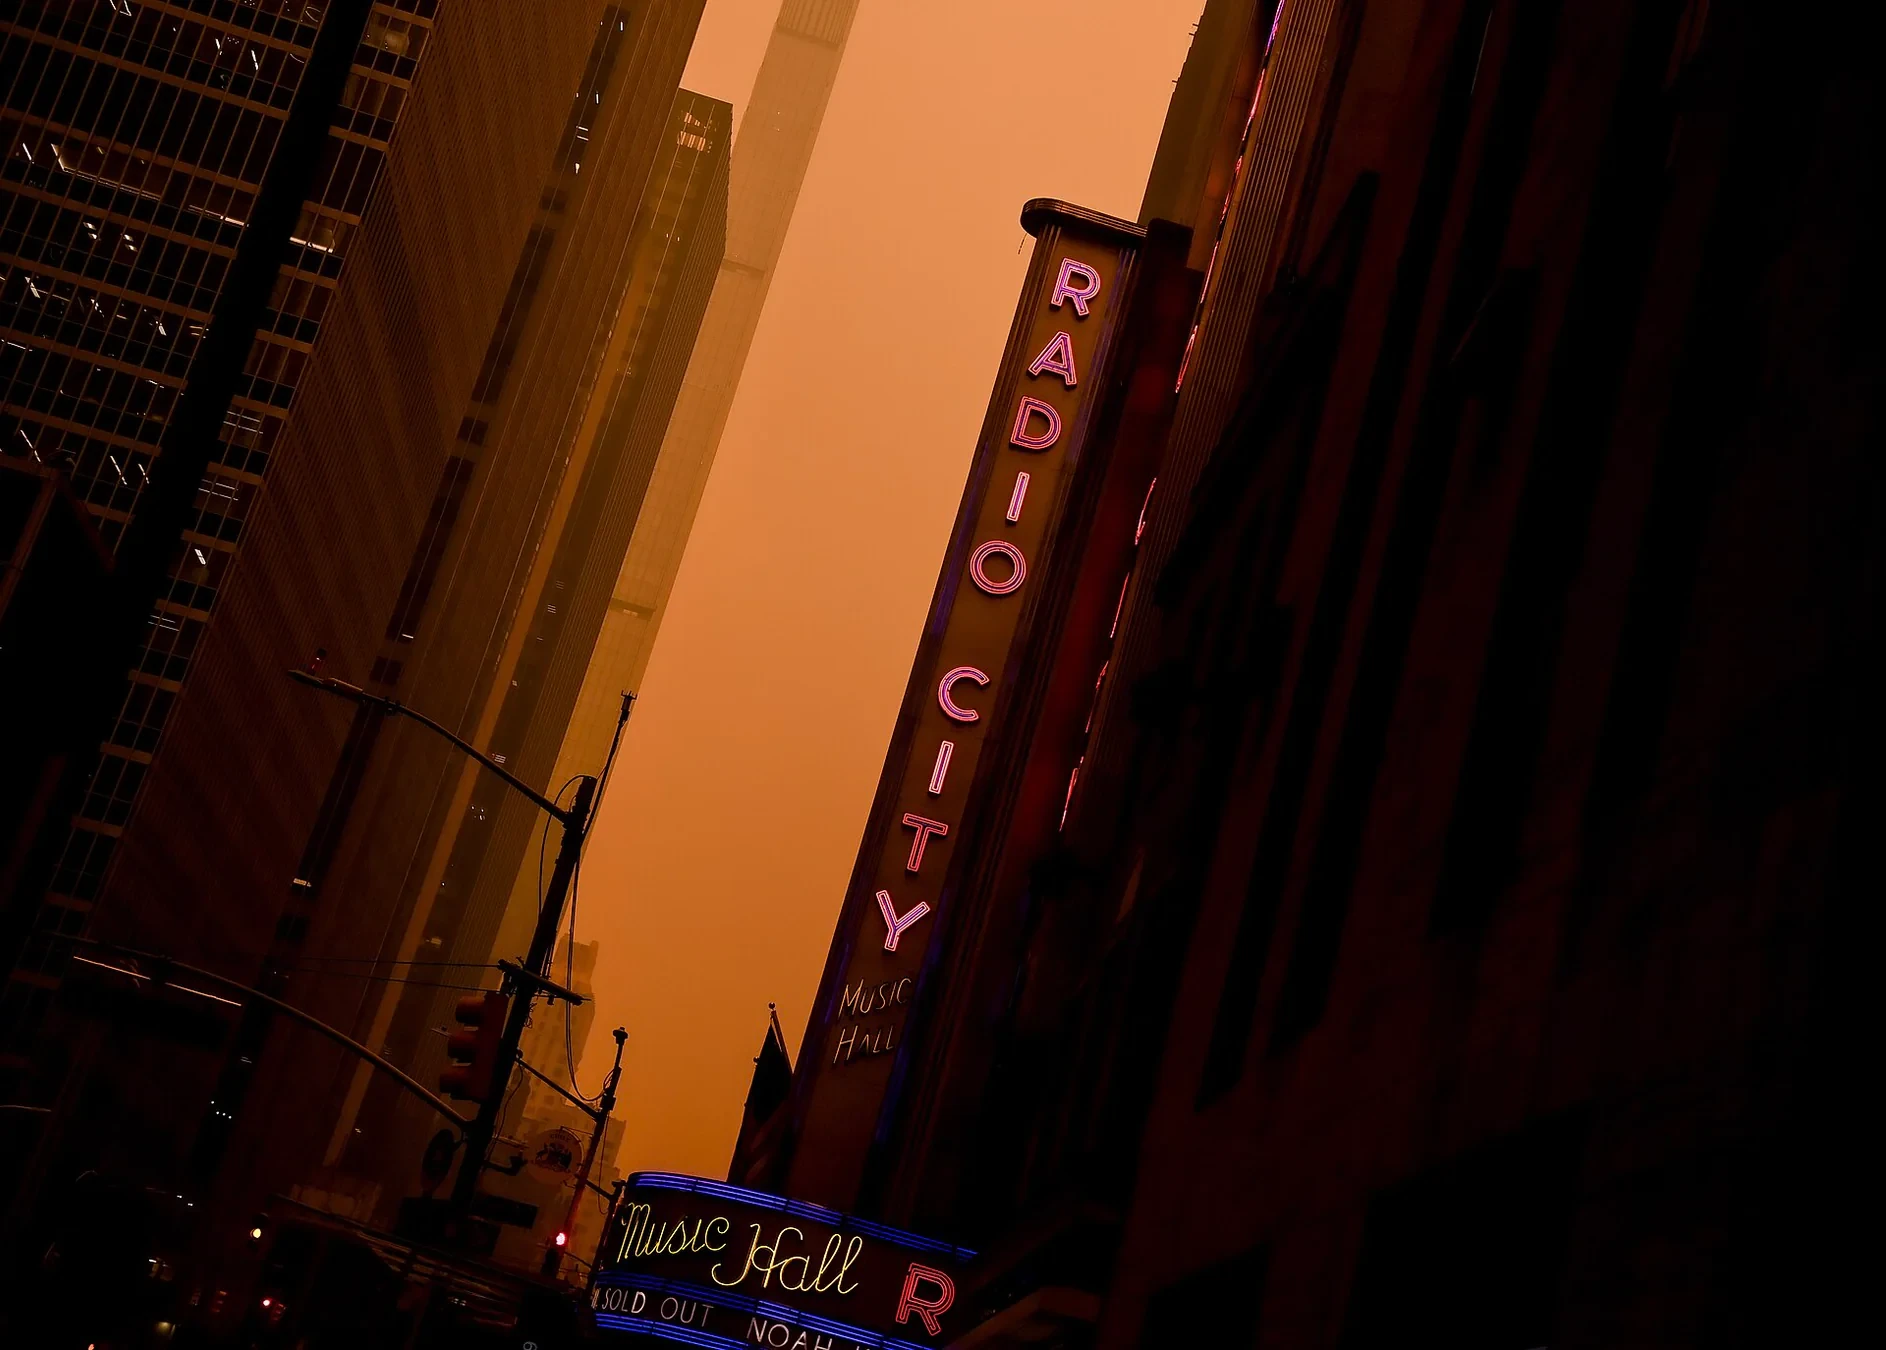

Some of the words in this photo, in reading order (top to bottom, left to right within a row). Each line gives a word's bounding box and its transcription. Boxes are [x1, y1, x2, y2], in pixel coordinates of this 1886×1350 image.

[969, 257, 1101, 595] RADIO
[875, 666, 990, 952] CITY
[837, 976, 912, 1020] MUSIC
[832, 1024, 896, 1064] HALL
[616, 1202, 730, 1263] Music
[711, 1223, 864, 1295] Hall
[601, 1287, 647, 1315] SOLD
[660, 1296, 715, 1328] OUT
[895, 1262, 956, 1337] R
